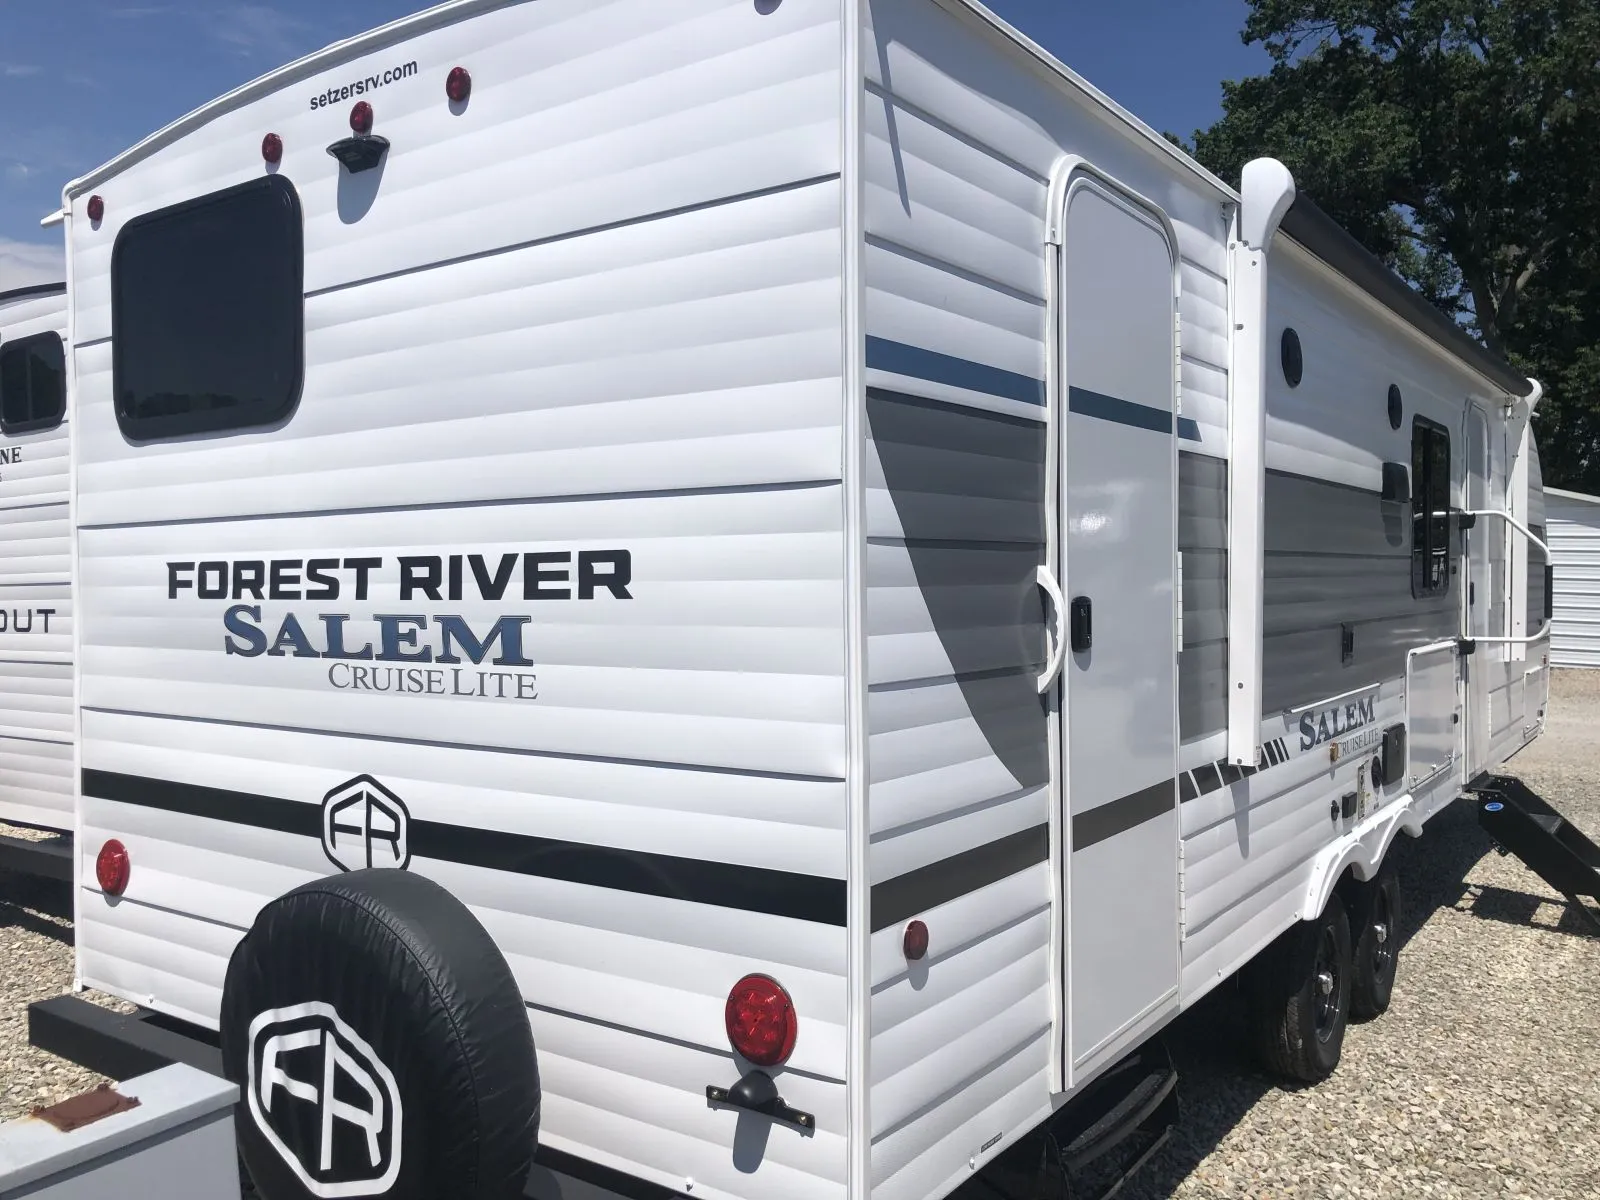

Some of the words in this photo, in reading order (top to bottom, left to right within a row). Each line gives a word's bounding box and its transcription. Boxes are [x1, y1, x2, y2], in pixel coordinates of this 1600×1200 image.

[310, 60, 418, 110] setzersrv.com
[166, 557, 383, 600] FOREST
[396, 549, 634, 601] RIVER
[223, 604, 534, 667] SALEM
[1299, 694, 1376, 752] SALEM
